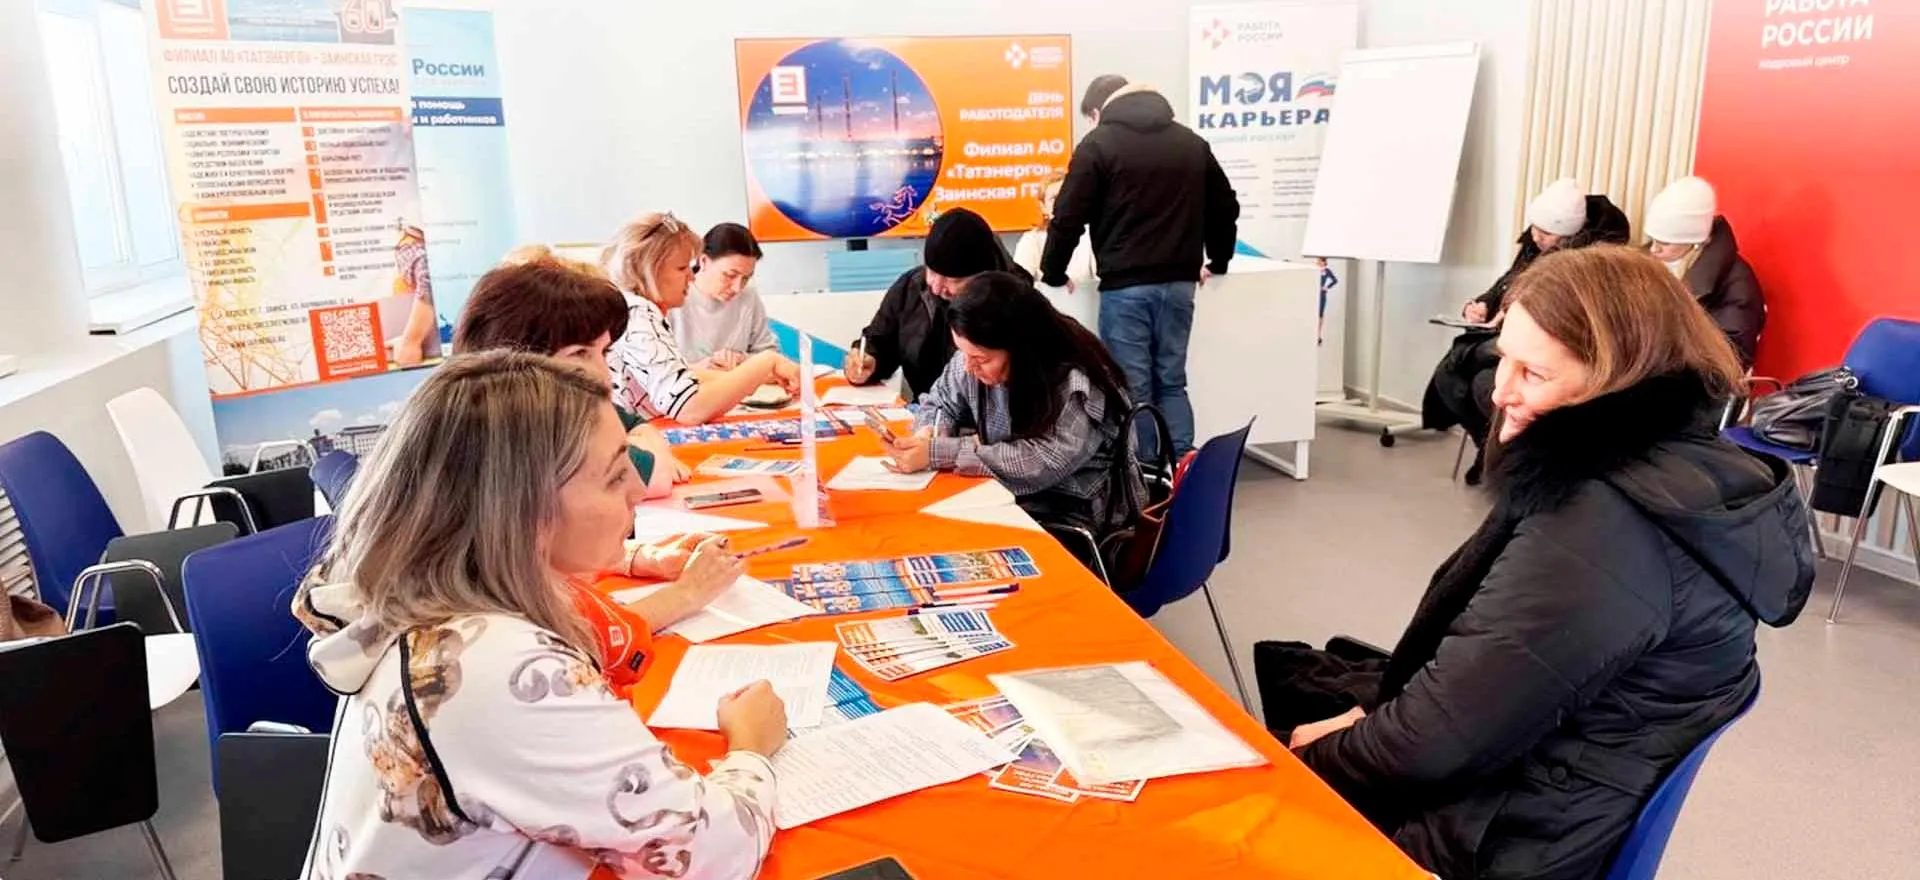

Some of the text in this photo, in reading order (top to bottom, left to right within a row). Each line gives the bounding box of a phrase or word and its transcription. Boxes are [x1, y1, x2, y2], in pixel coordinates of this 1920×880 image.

[1762, 14, 1873, 49] РОССИИ
[411, 58, 485, 77] России
[168, 72, 400, 95] СОЗДАЙ СВОЮ ИСТОРИЮ УСПЕХА!
[1200, 72, 1291, 105] МОЯ
[1028, 92, 1064, 106] ДЕНЬ
[960, 107, 1064, 121] РАБОТОДАТЕЛЯ
[1199, 108, 1330, 128] КАРЬЕРА
[964, 139, 1065, 157] Филиал АО
[947, 163, 1052, 181] «Татэнерго»
[935, 186, 1017, 203] Заинская
